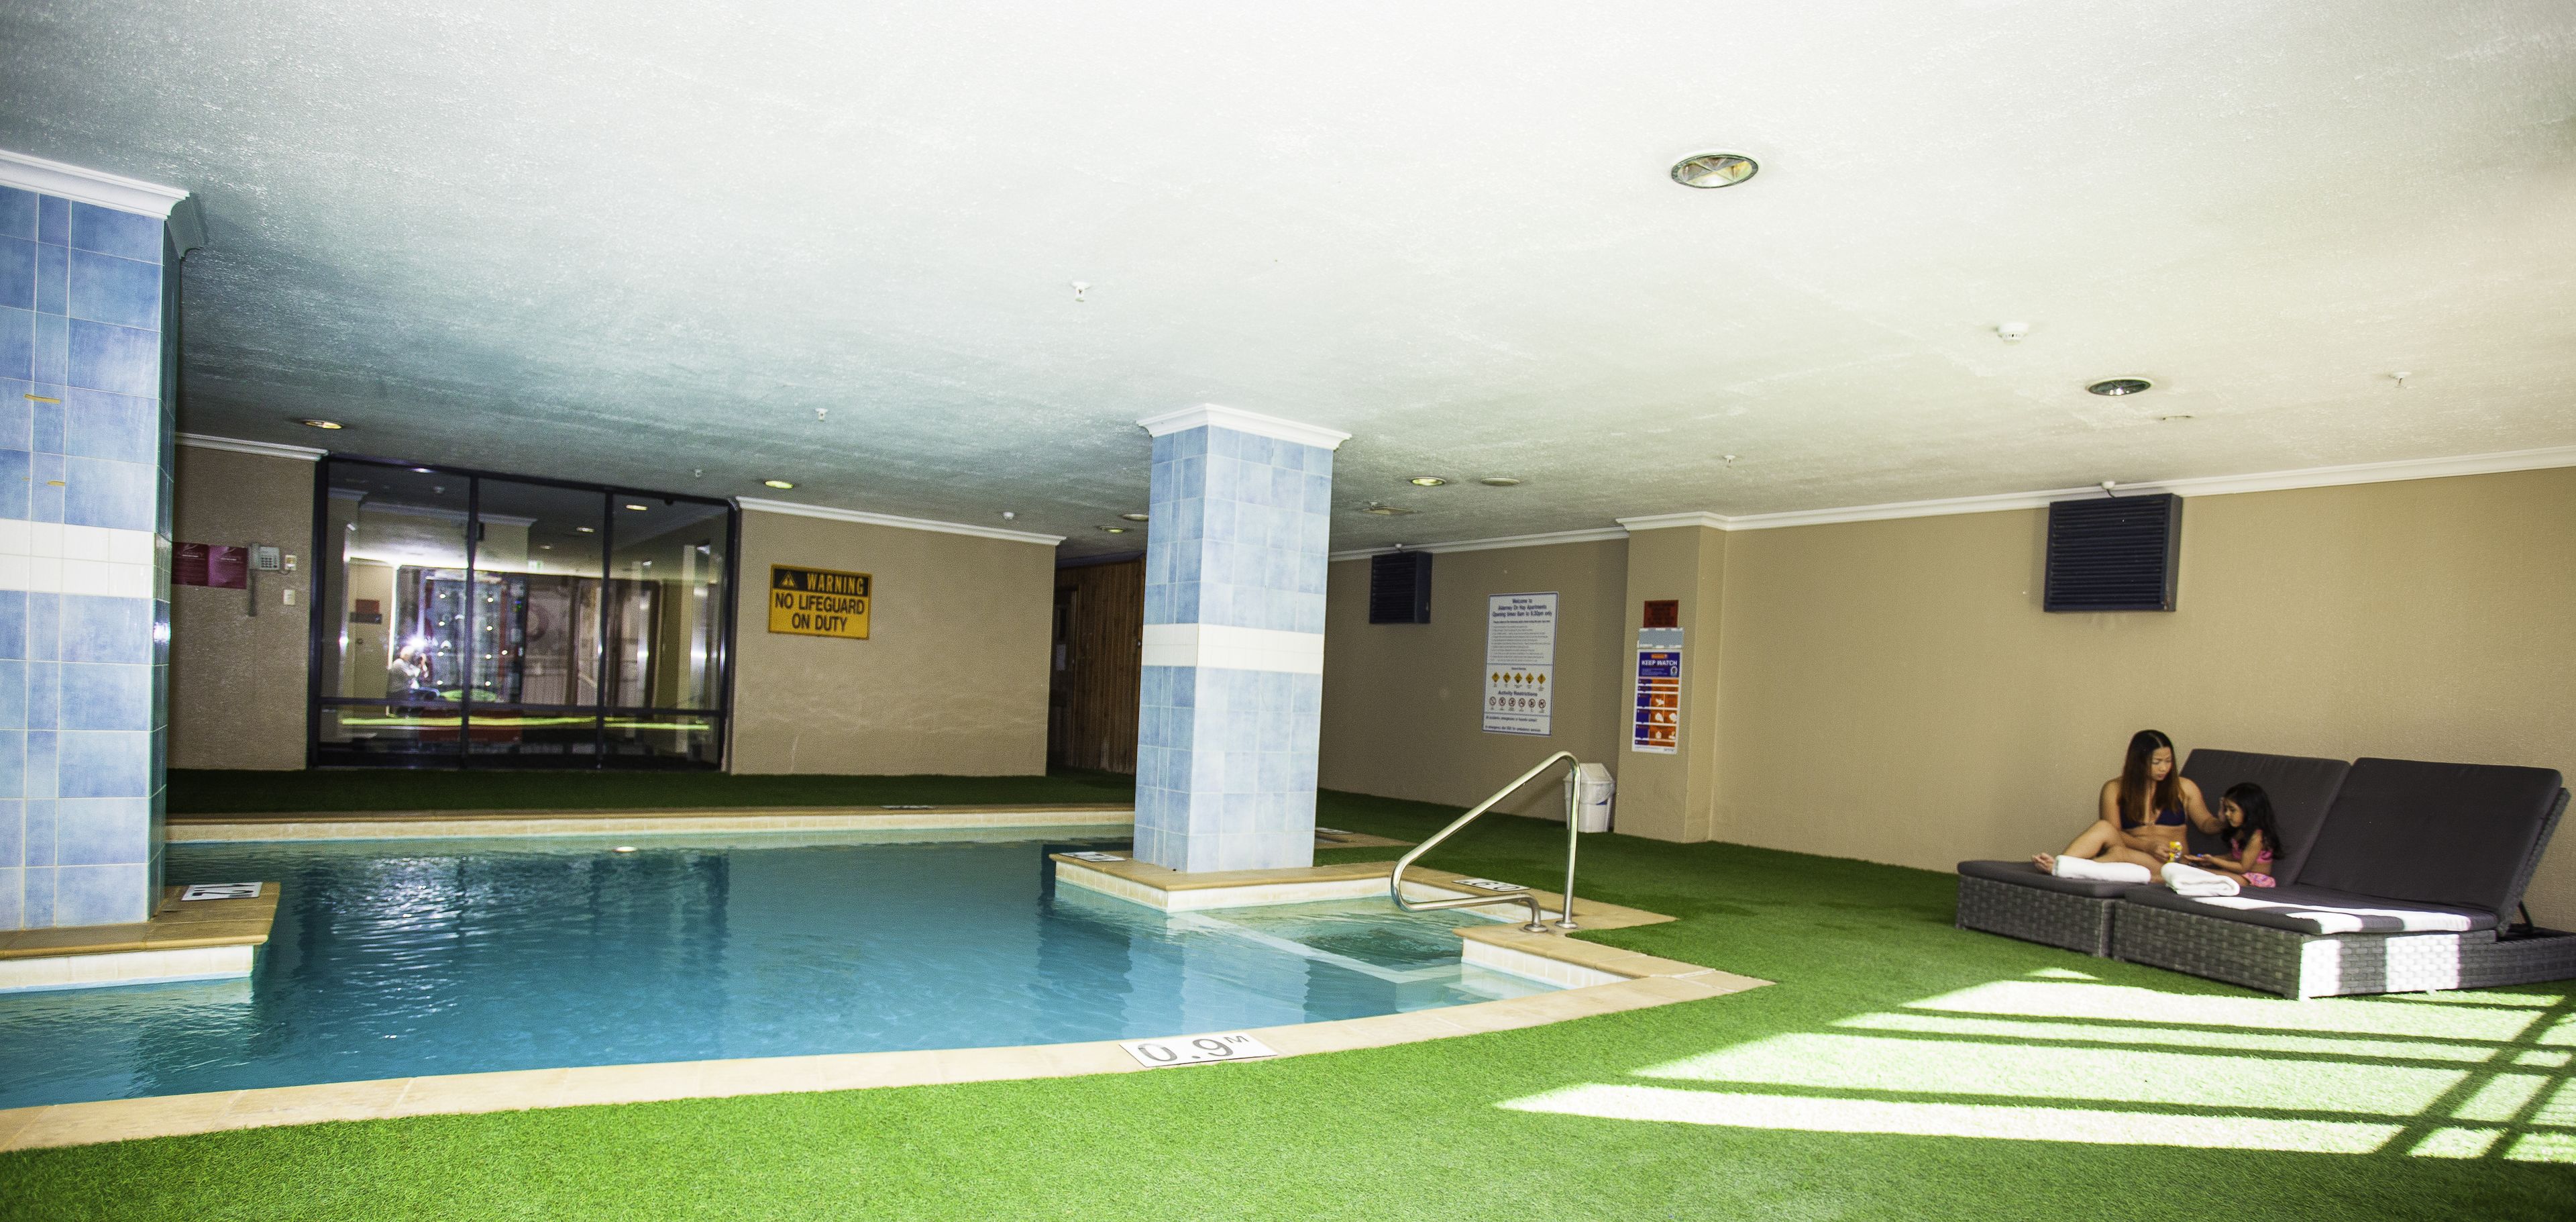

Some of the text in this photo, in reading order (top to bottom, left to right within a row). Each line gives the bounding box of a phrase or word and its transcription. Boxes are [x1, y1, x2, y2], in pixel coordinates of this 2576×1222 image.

[807, 572, 864, 595] WARNING
[775, 593, 864, 615] NO LIFEGUARD
[792, 612, 847, 632] ON DUTY
